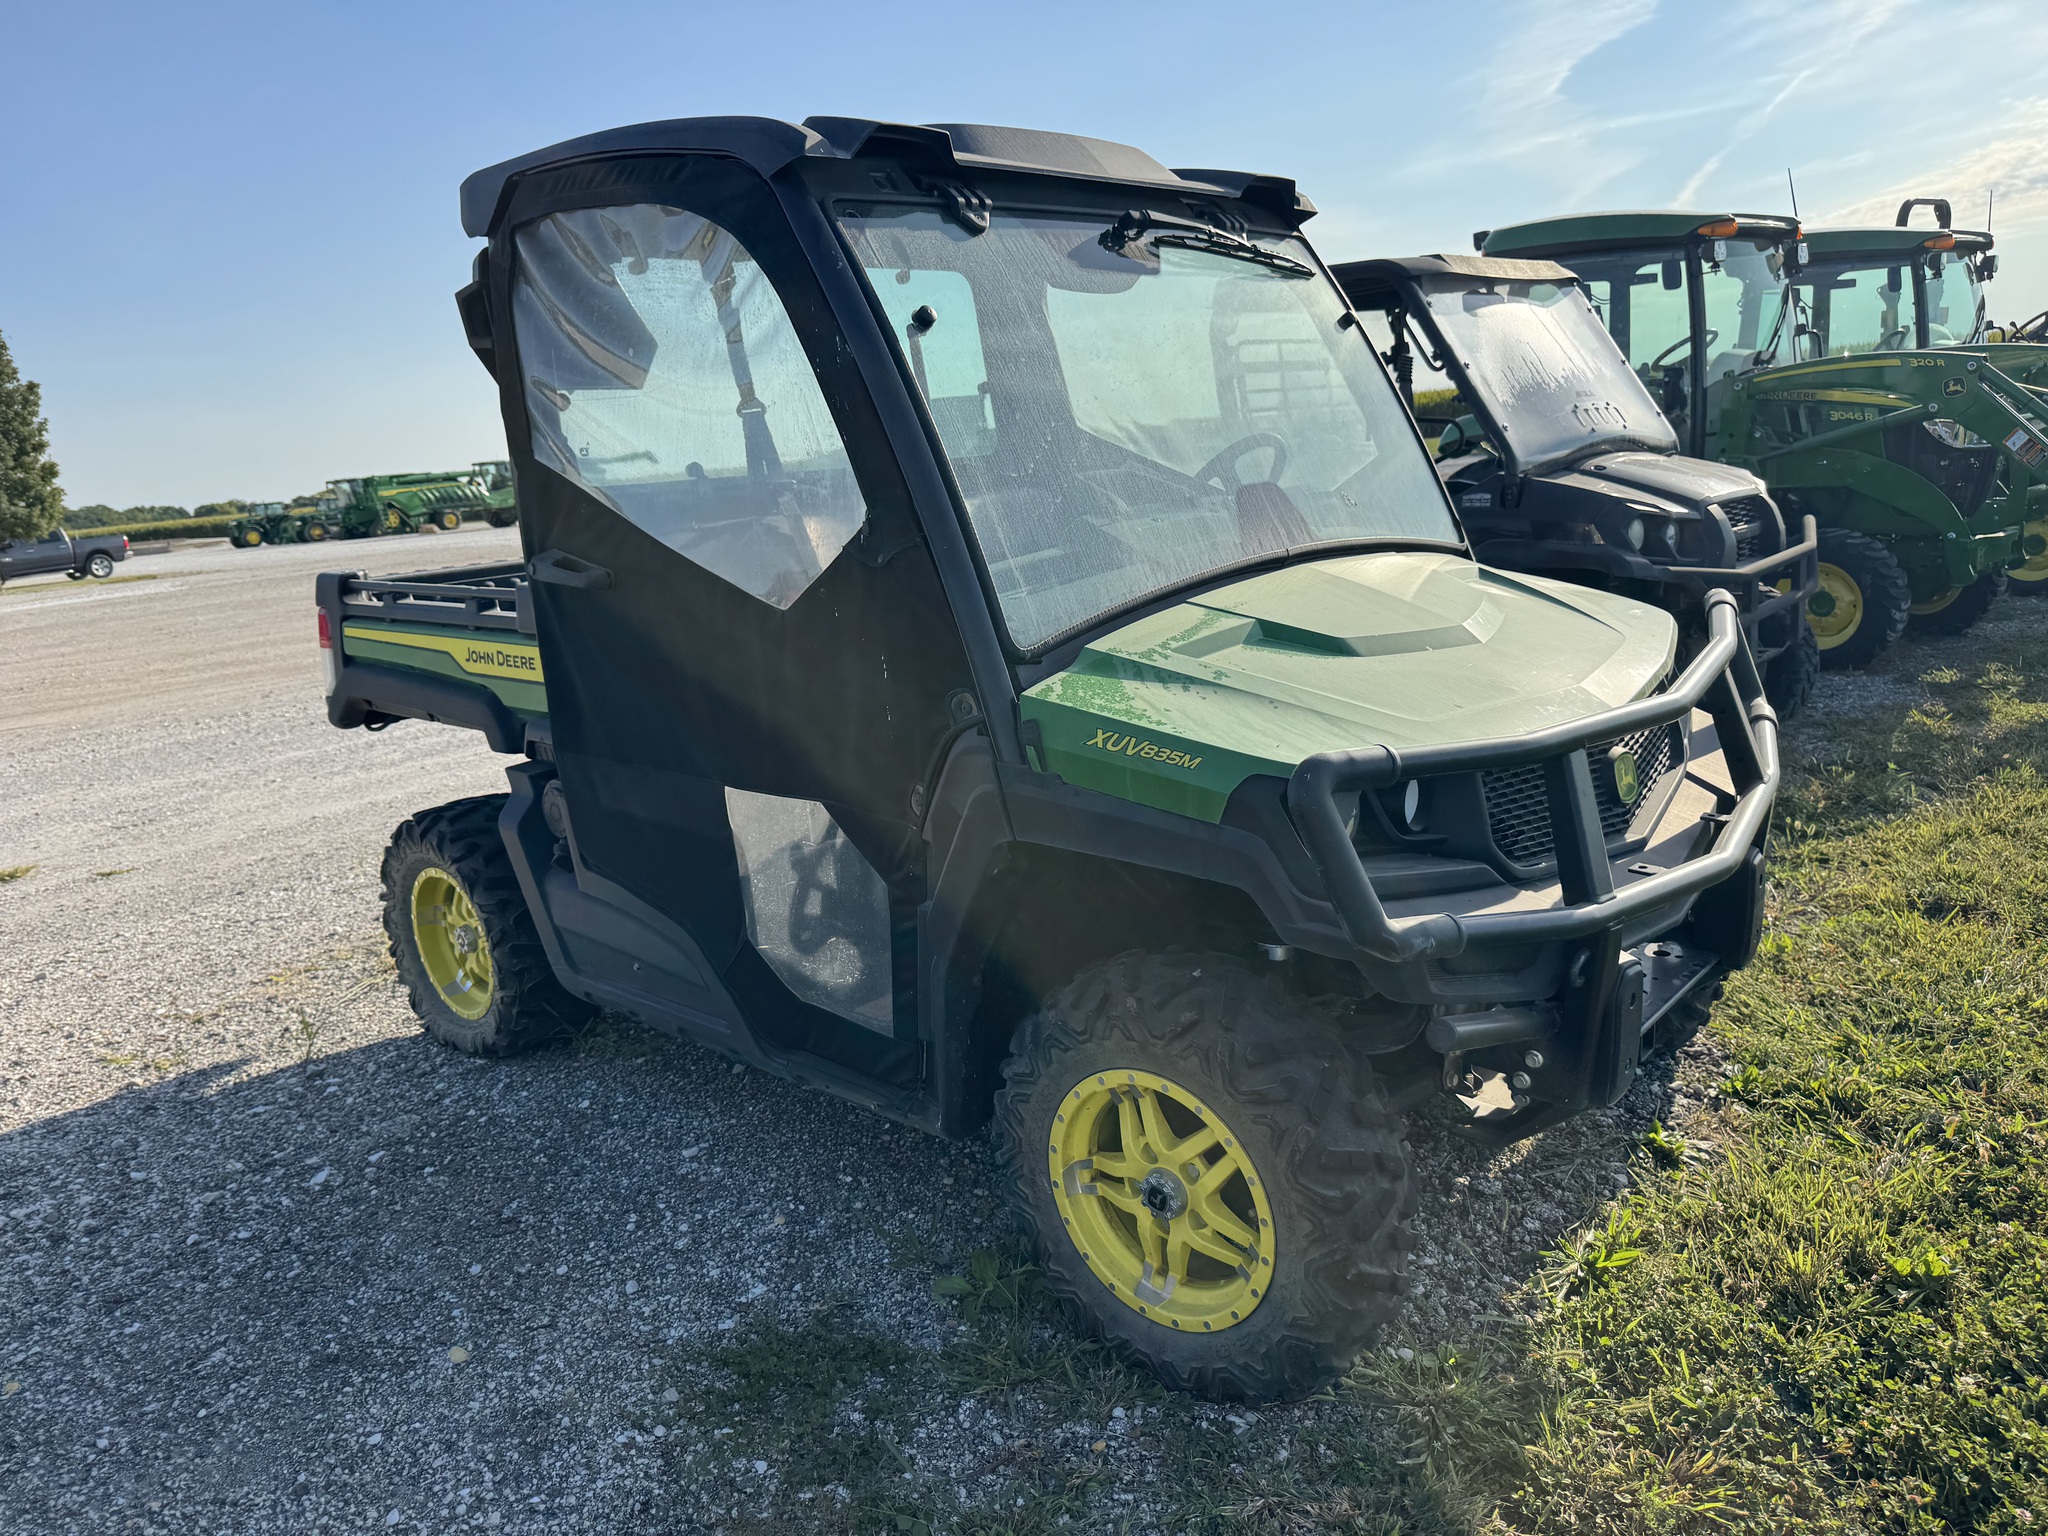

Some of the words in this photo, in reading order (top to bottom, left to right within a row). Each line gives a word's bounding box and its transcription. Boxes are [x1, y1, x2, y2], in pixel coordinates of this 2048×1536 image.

[1909, 358, 1934, 367] 320
[1936, 358, 1946, 367] R
[1779, 391, 1817, 402] DEERE
[1829, 410, 1863, 421] 3046
[1864, 412, 1873, 421] R
[465, 647, 495, 665] JOHN
[496, 650, 536, 671] DEERE
[1083, 727, 1205, 770] XUV835M
